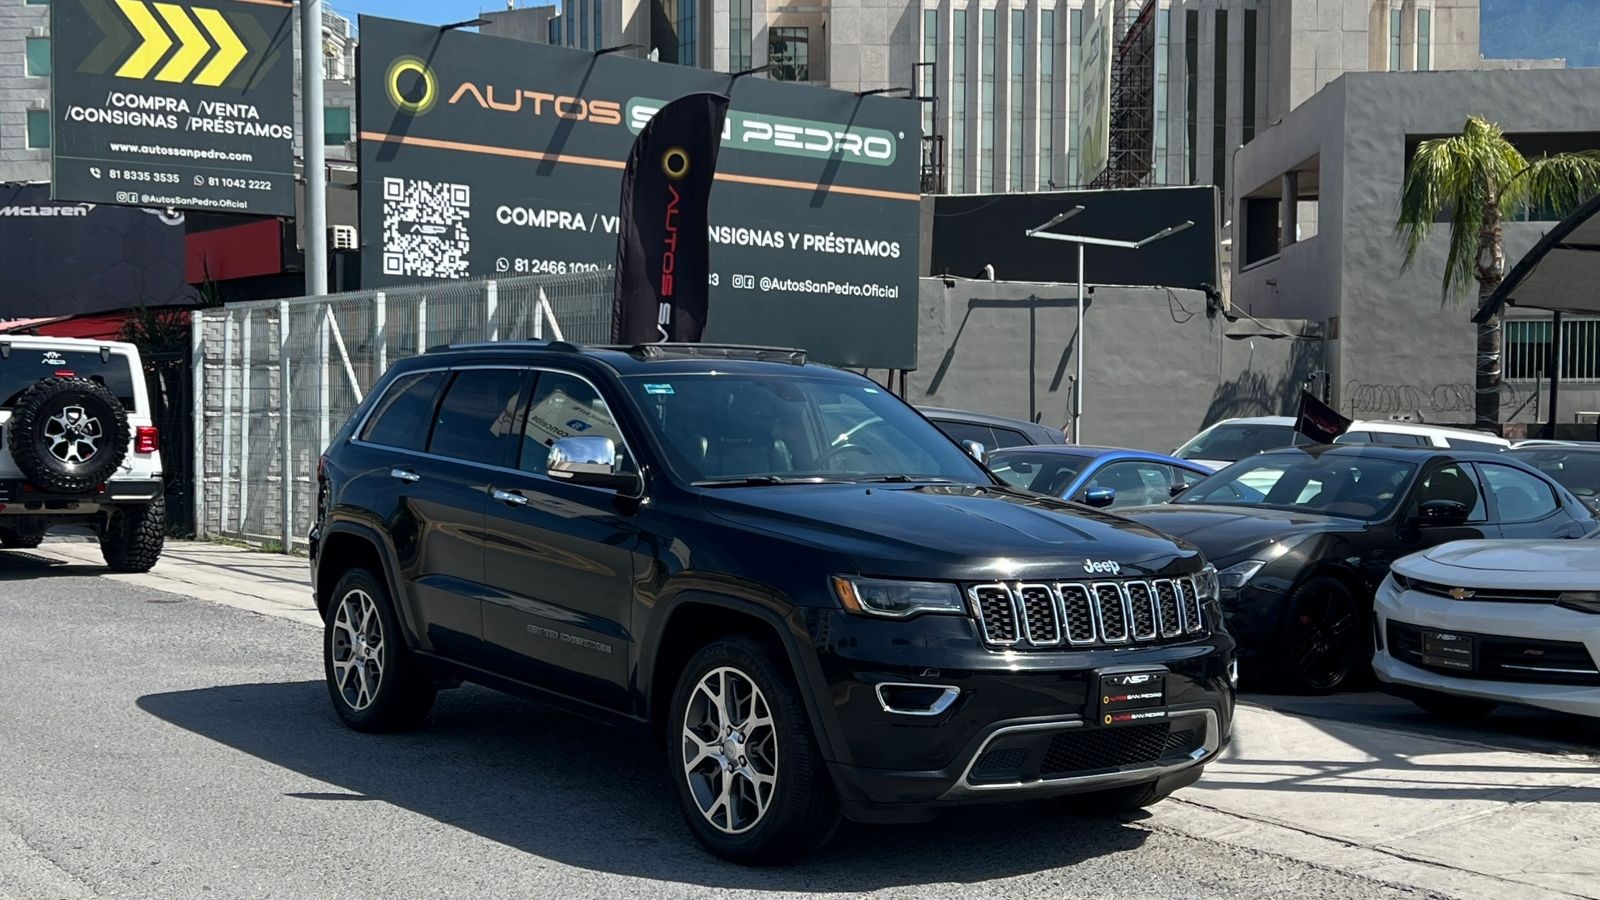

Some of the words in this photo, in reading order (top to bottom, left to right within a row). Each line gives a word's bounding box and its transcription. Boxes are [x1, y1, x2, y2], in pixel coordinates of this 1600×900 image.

[448, 82, 621, 125] AUTOS
[743, 120, 892, 159] PEDRO
[110, 143, 252, 161] www.autossanpedro.com
[109, 169, 121, 179] 81
[123, 170, 151, 181] 8335
[153, 173, 180, 183] 3535
[208, 177, 219, 186] 81
[221, 178, 246, 189] 1042
[248, 180, 272, 190] 2222
[141, 194, 248, 208] @AutosSanPedro.Oficial
[0, 205, 87, 217] McLaren
[496, 206, 587, 231] COMPRA
[788, 231, 801, 249] Y
[803, 232, 900, 258] PRÉSTAMOS
[660, 184, 680, 296] AUTOS
[514, 258, 529, 273] 81
[531, 259, 566, 275] 2466
[760, 276, 899, 298] @AutosSanPedro.Oficial
[1084, 559, 1121, 575] Jeep
[1122, 675, 1150, 685] ASP
